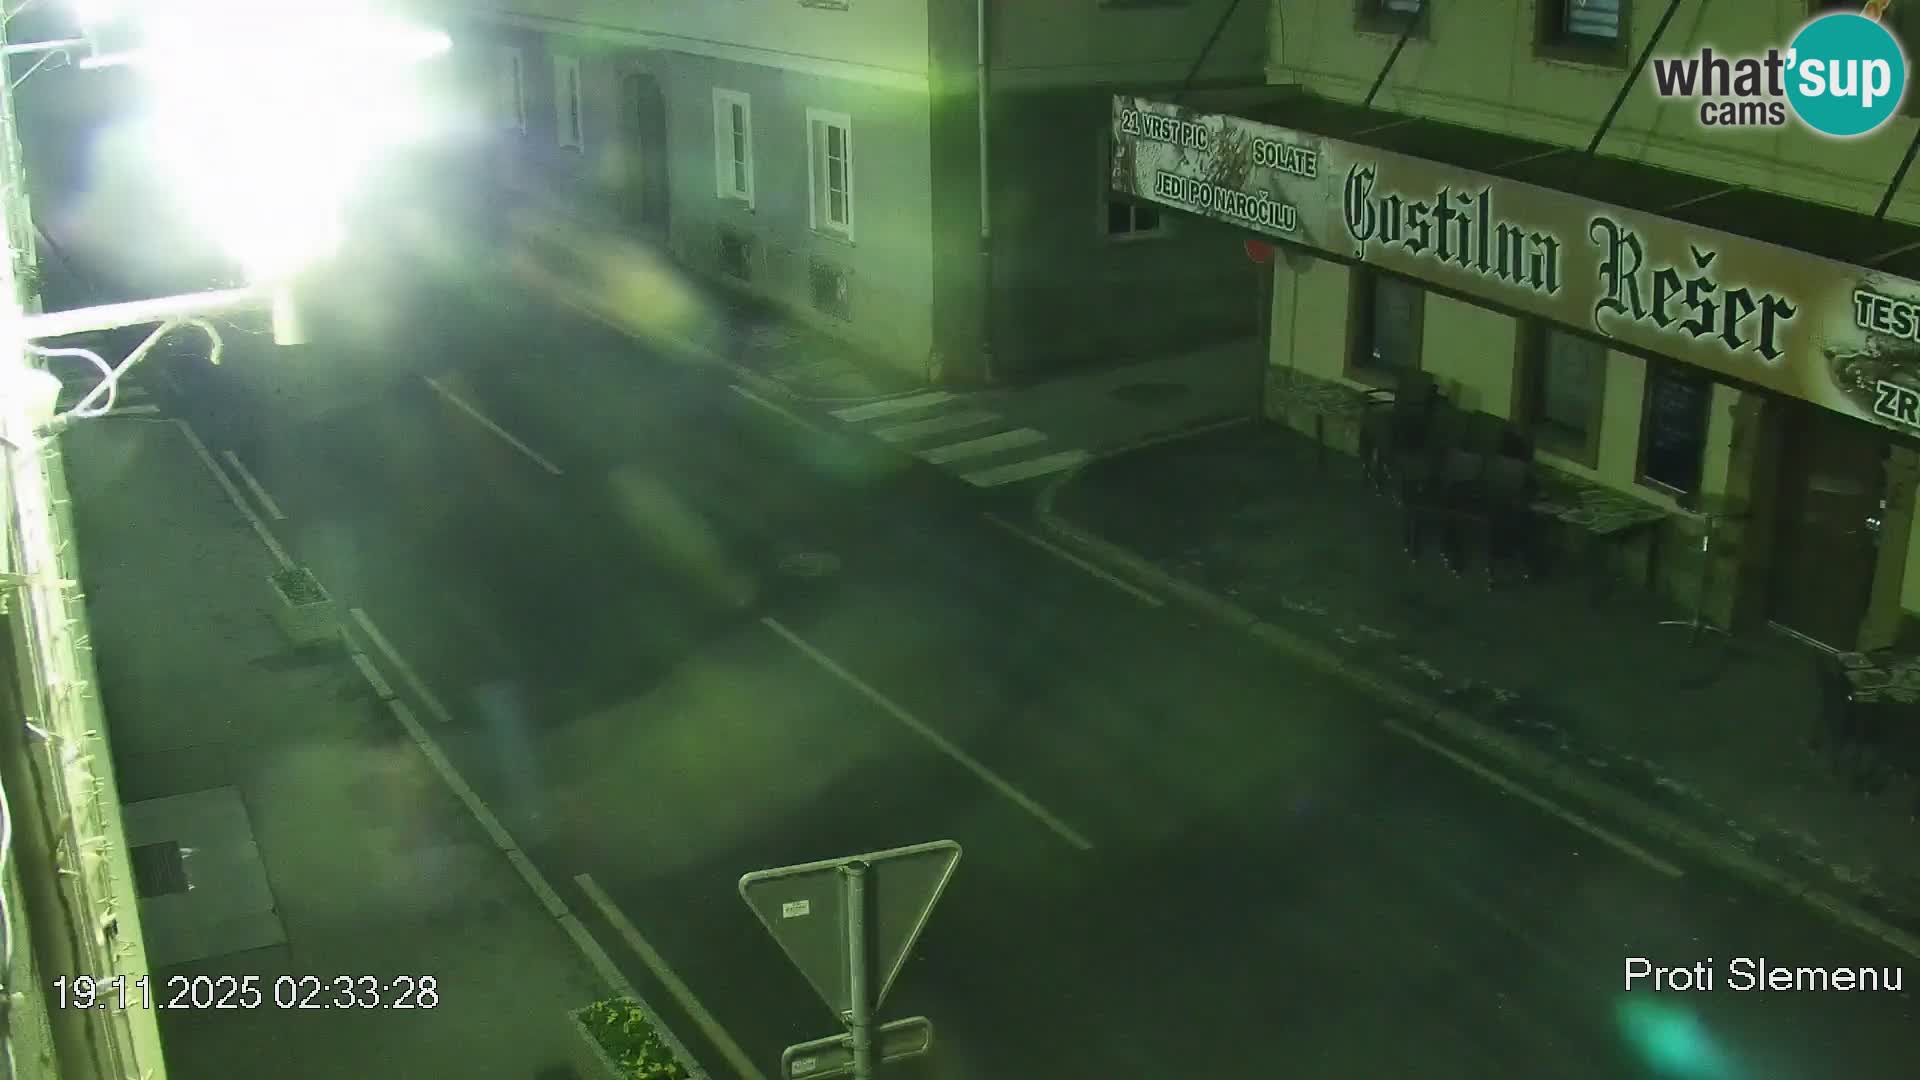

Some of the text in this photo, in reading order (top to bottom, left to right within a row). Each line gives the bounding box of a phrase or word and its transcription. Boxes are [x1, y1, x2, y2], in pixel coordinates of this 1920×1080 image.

[1121, 109, 1140, 135] 21
[1142, 112, 1181, 145] VRST
[1252, 140, 1317, 177] SOLATE
[1155, 171, 1297, 232] JEDI PO NAROČILU
[1343, 161, 1798, 361] Gostilna Rešer
